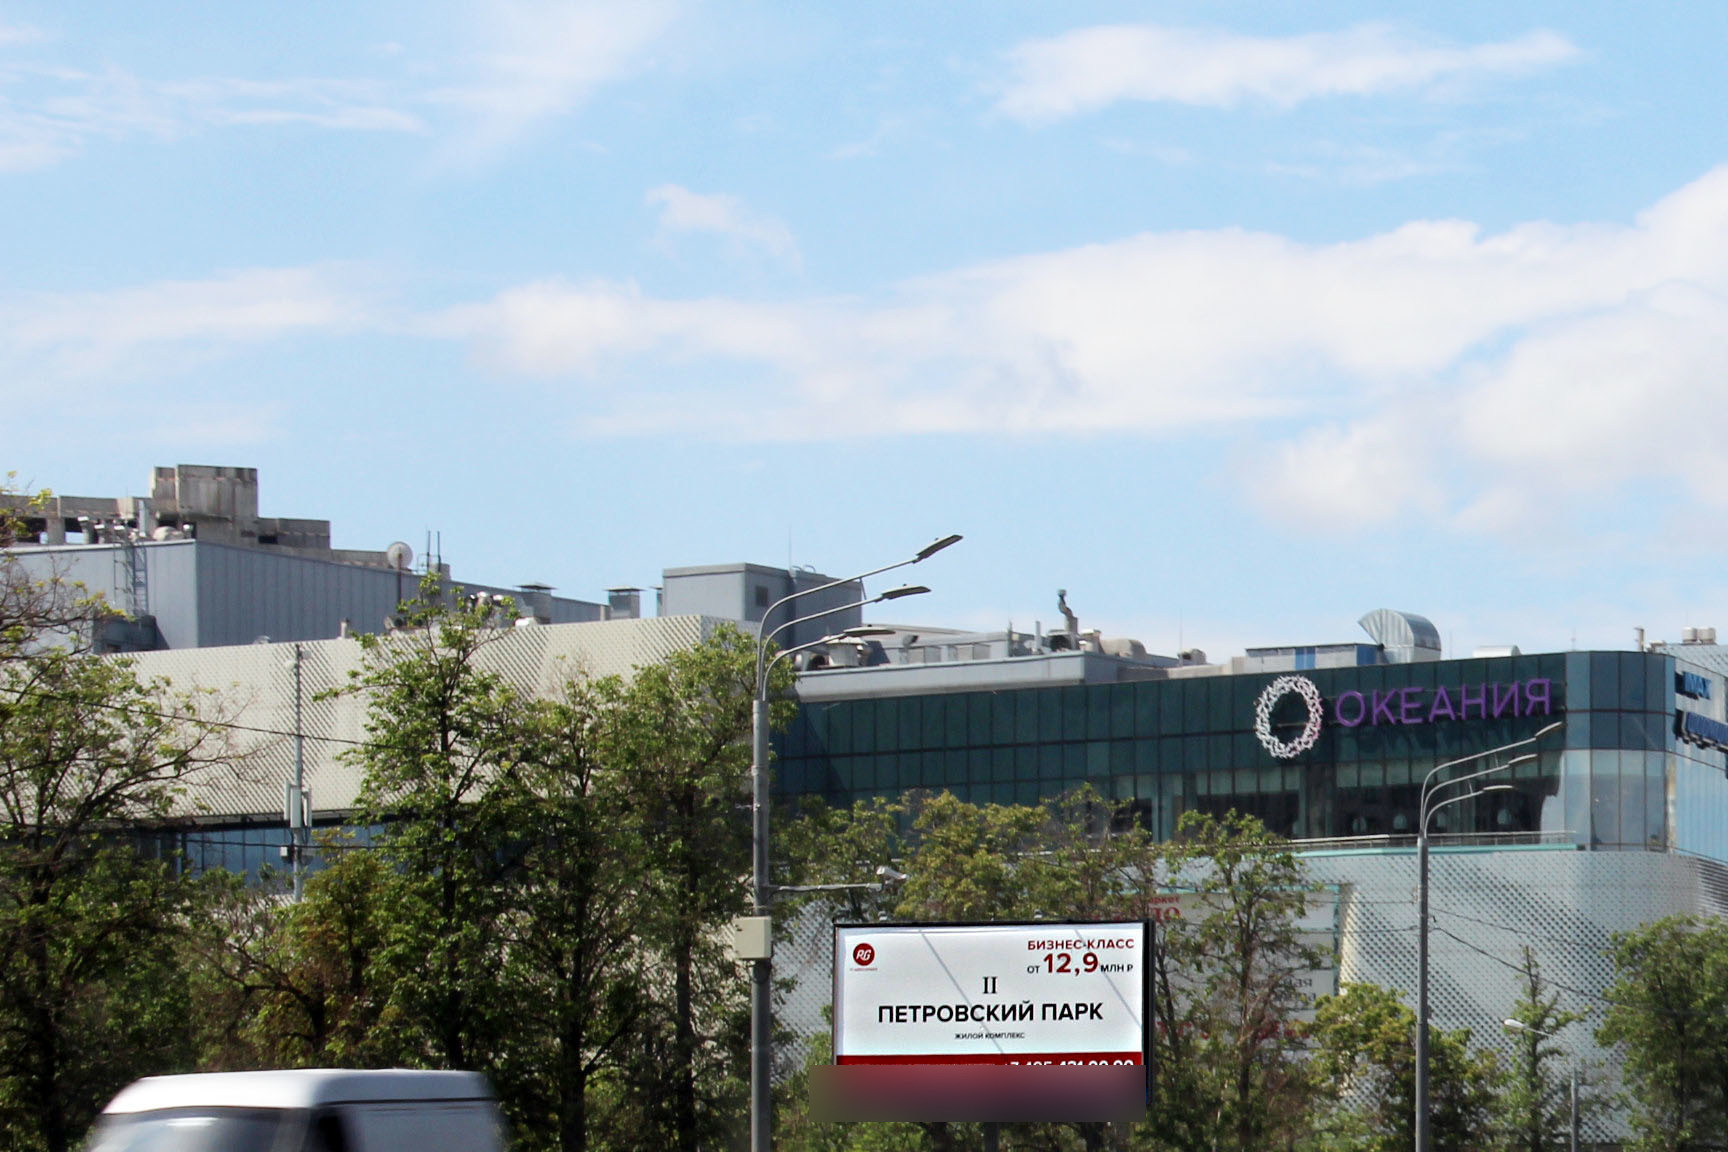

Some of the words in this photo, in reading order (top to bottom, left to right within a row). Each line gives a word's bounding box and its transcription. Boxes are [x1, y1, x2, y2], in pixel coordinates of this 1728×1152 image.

[1335, 678, 1551, 727] ОКЕАНИЯ
[1027, 938, 1135, 951] БИЗНЕС-КЛАСС
[1027, 965, 1040, 974] ОТ
[1043, 952, 1099, 976] 12,9
[1100, 964, 1124, 973] МЛН
[982, 976, 998, 994] II
[878, 1000, 1034, 1023] ПЕТРОВСКИЙ
[1042, 1002, 1103, 1021] ПАРК
[954, 1032, 984, 1040] ЖИЛОЙ
[985, 1031, 1026, 1040] КОМПЛЕКС
